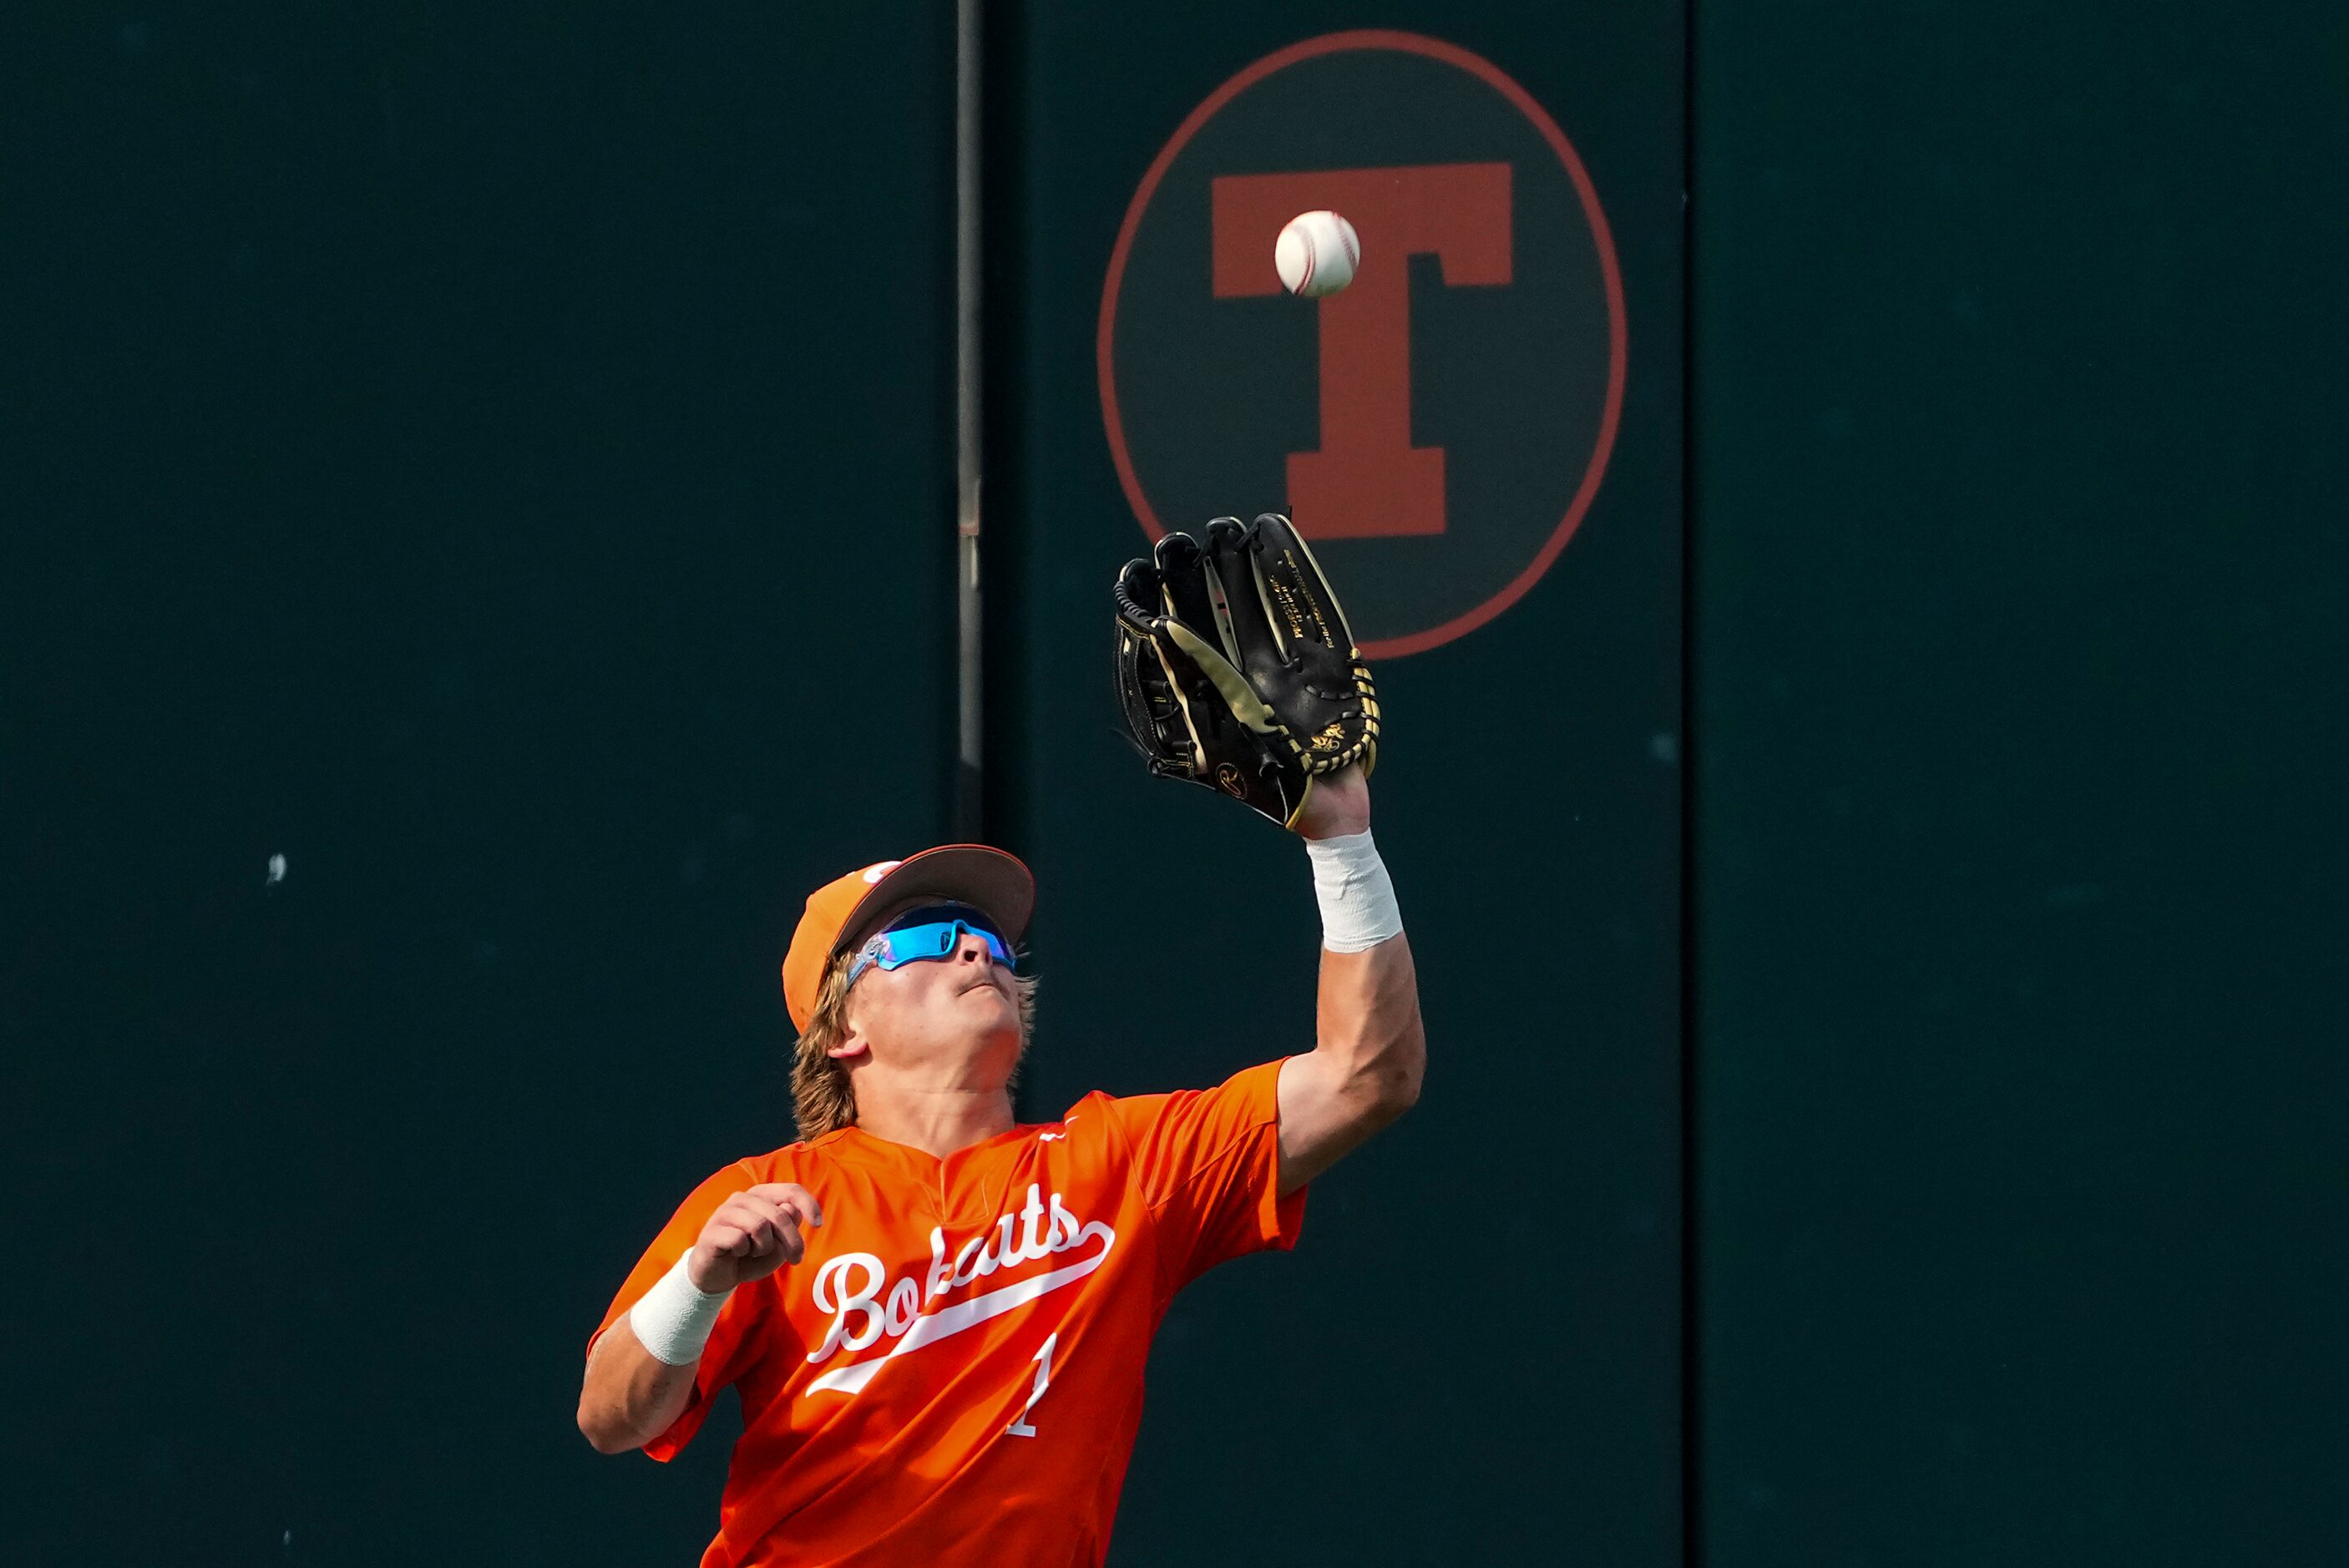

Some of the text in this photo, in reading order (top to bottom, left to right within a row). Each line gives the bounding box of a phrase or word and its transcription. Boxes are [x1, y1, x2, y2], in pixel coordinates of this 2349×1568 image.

[1212, 162, 1513, 540] T
[807, 1183, 1116, 1364] Bobcats
[1006, 1333, 1057, 1437] 1
